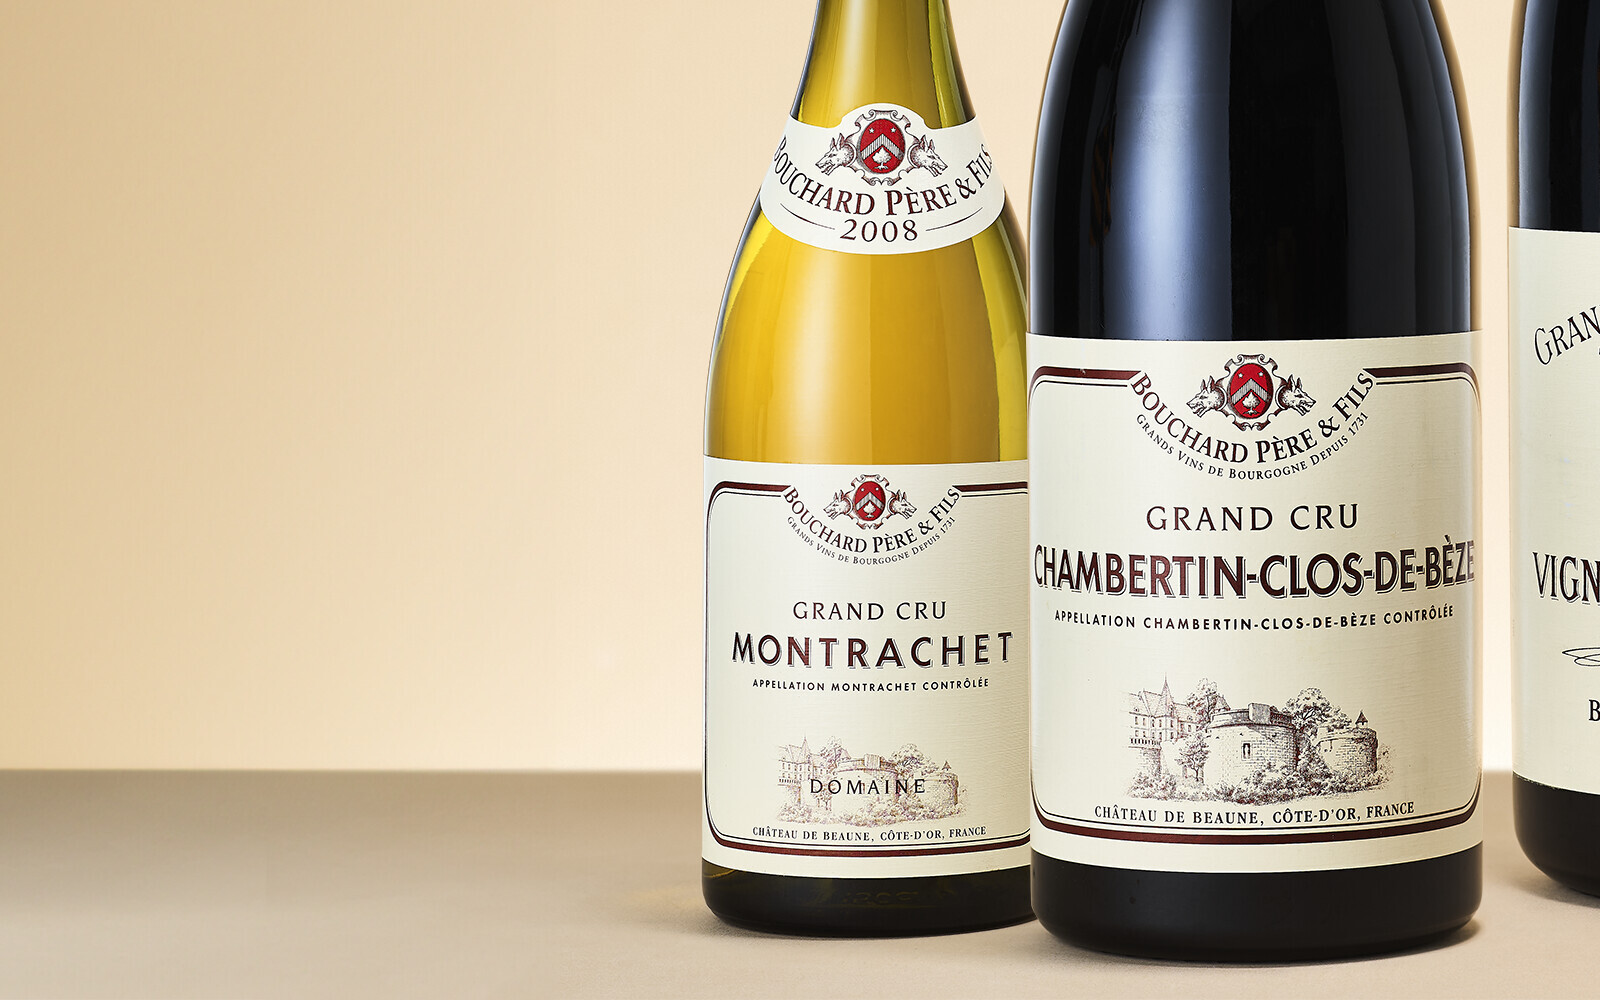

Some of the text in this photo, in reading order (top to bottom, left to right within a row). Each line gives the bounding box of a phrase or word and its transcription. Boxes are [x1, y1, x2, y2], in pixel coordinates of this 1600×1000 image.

[773, 136, 992, 216] BOUCHARD PÈRE & FILS
[840, 219, 918, 243] 2008
[1130, 372, 1374, 463] BOUCHARD PÈRE & FILS
[1136, 412, 1369, 480] GRANDS VINS DE BOURGOGNE DEPUIS 1731
[784, 487, 960, 553] BOUCHARD PÈRE & FILS
[1146, 503, 1359, 532] GRAND CRU
[787, 516, 955, 565] GRANDS VINS DE BOURGOGNE DEPUIS 1731
[1034, 535, 1476, 600] CHAMBERTIN-CLOS-DE-BÈZE
[793, 601, 947, 621] GRAND CRU
[1054, 605, 1455, 631] APPELLATION CHAMBERTIN-CLOS-DE-BÈZE CONTRÔLÉE
[732, 631, 1013, 669] MONTRACHET
[752, 676, 989, 692] APPELLATION MONTRACHET CONTRÔLÉE
[809, 778, 926, 795] DOMAINE
[1094, 801, 1415, 828] CHÂTEAU DE BEAUNE, CÔTE-D'OR, FRANCE
[752, 825, 987, 843] CHÂTEAU DE BEAUNE, CÔTE-D'OR, FRANCE
